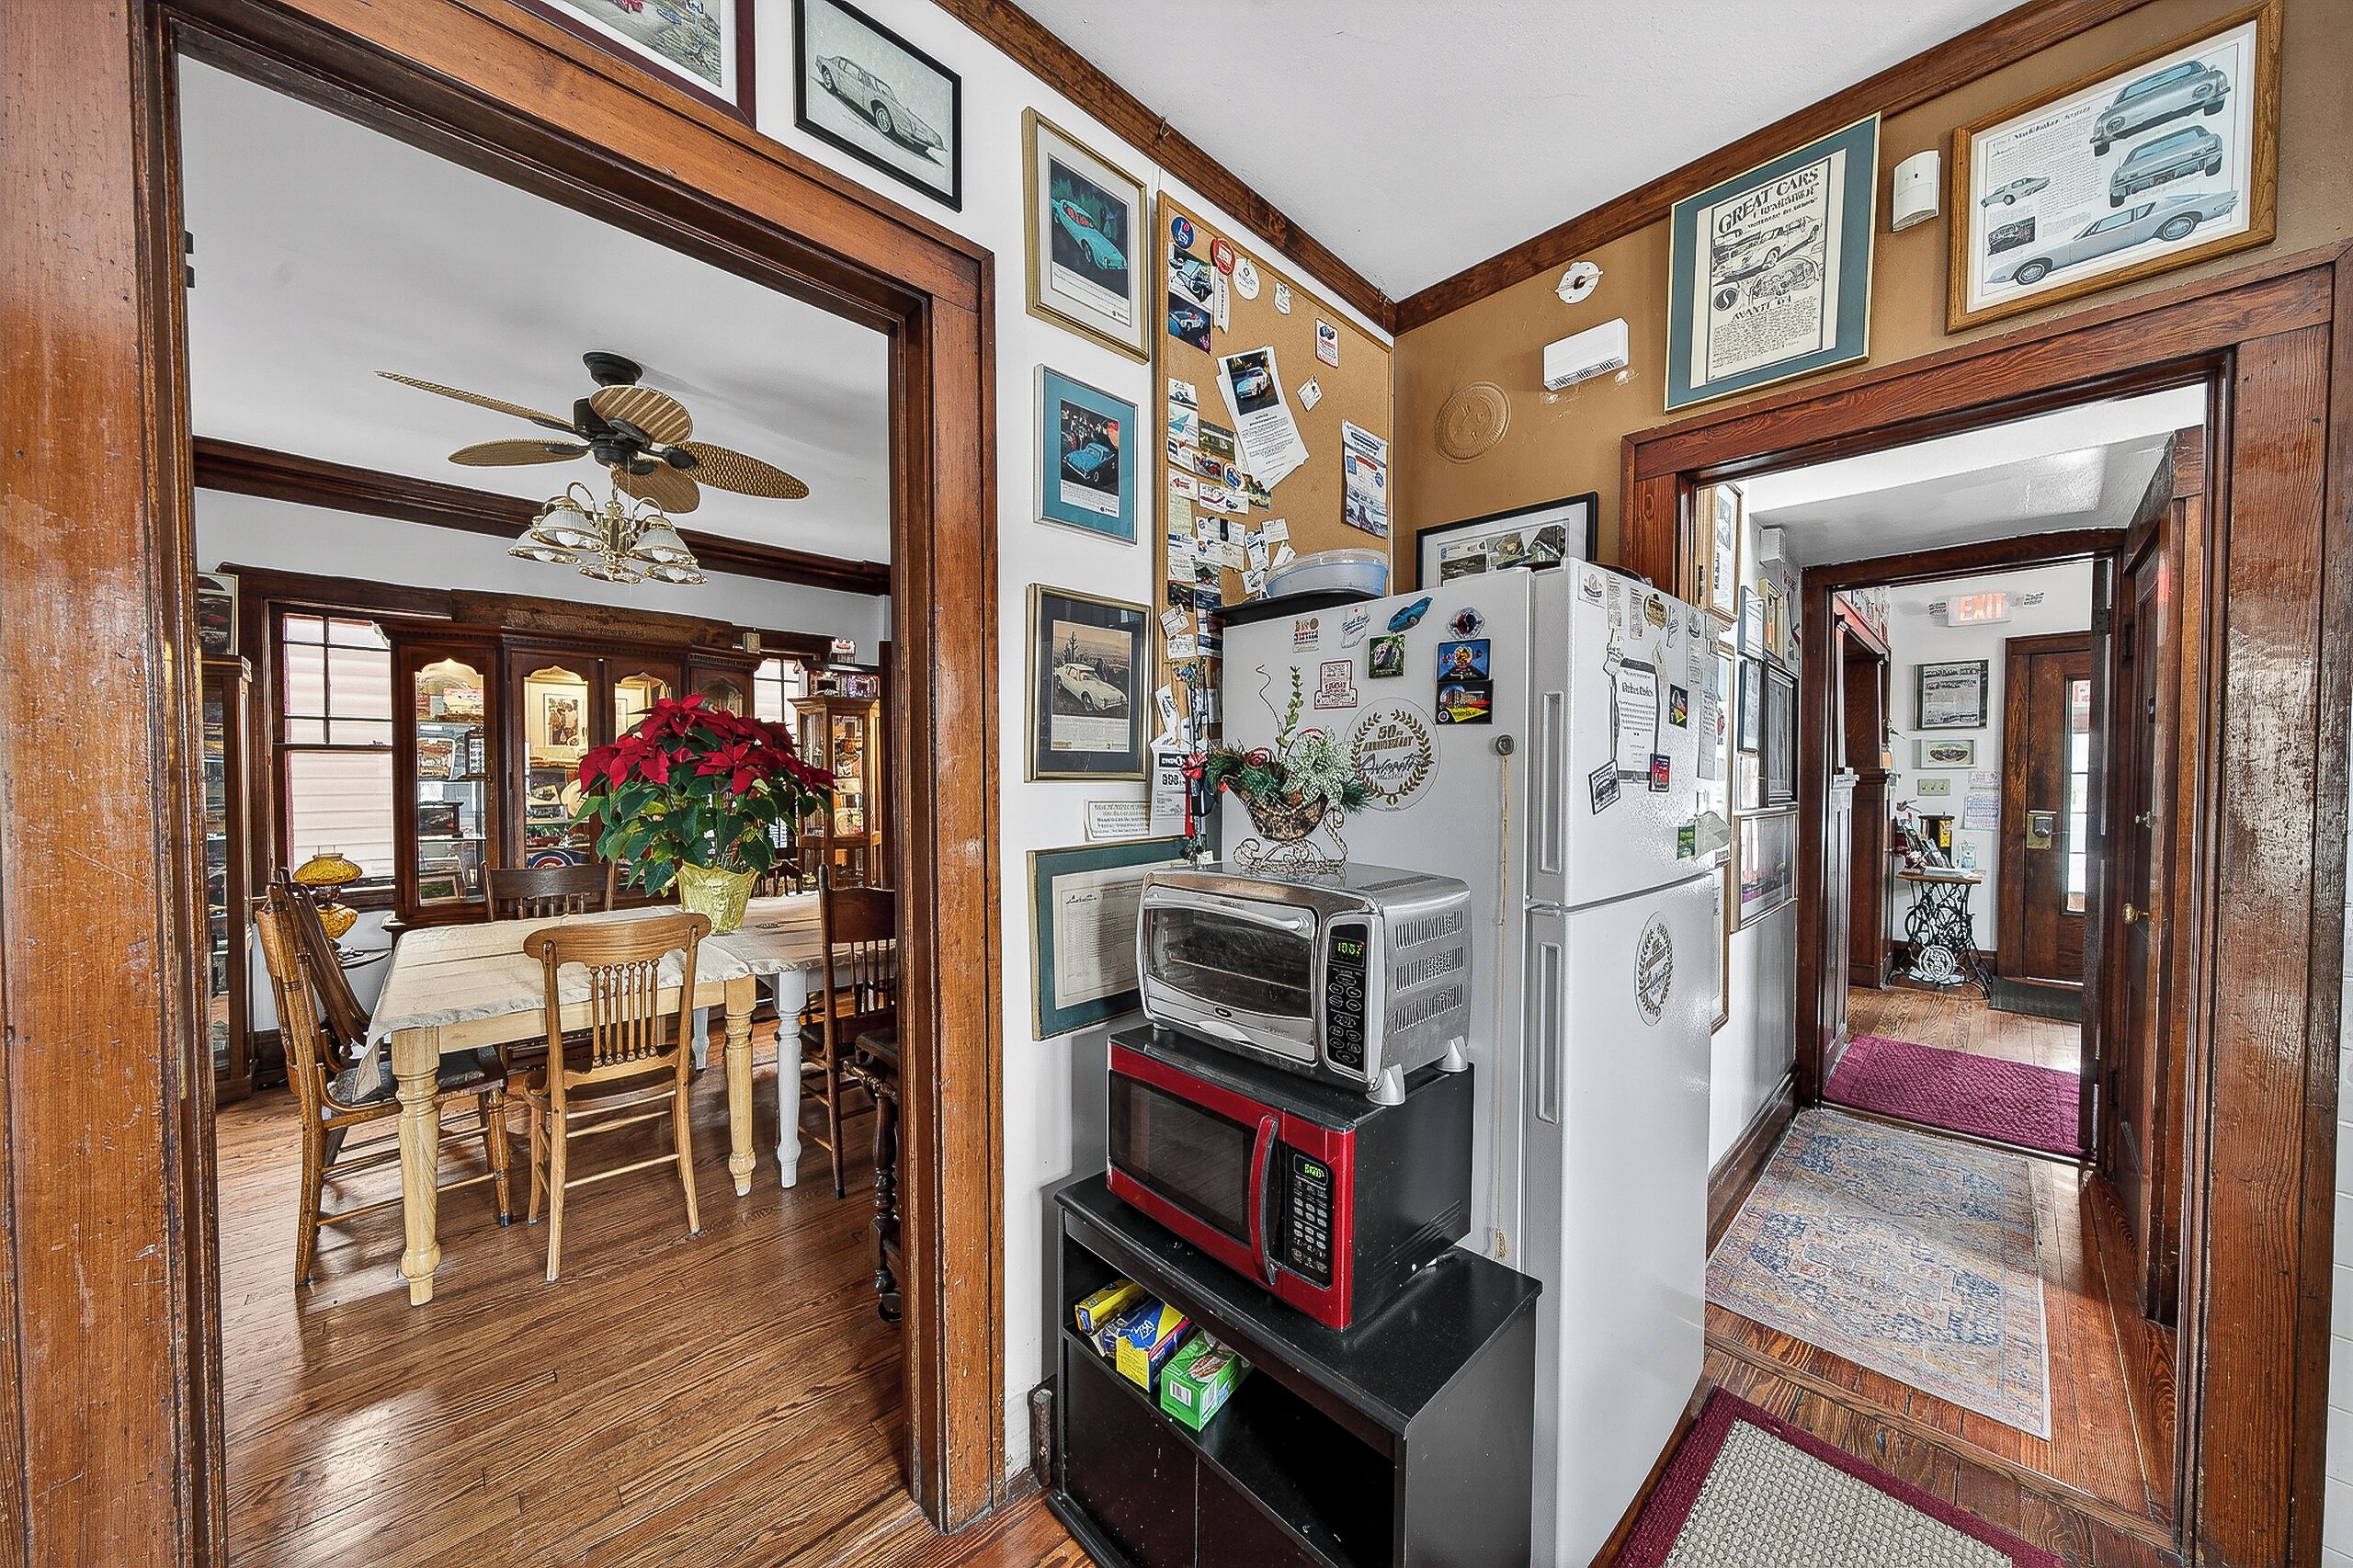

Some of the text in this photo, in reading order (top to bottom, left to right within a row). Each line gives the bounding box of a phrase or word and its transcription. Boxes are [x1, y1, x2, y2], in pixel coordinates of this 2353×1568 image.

[1718, 187, 1773, 233] GREAT
[1777, 167, 1819, 196] CARS
[1960, 592, 2006, 620] EXIT
